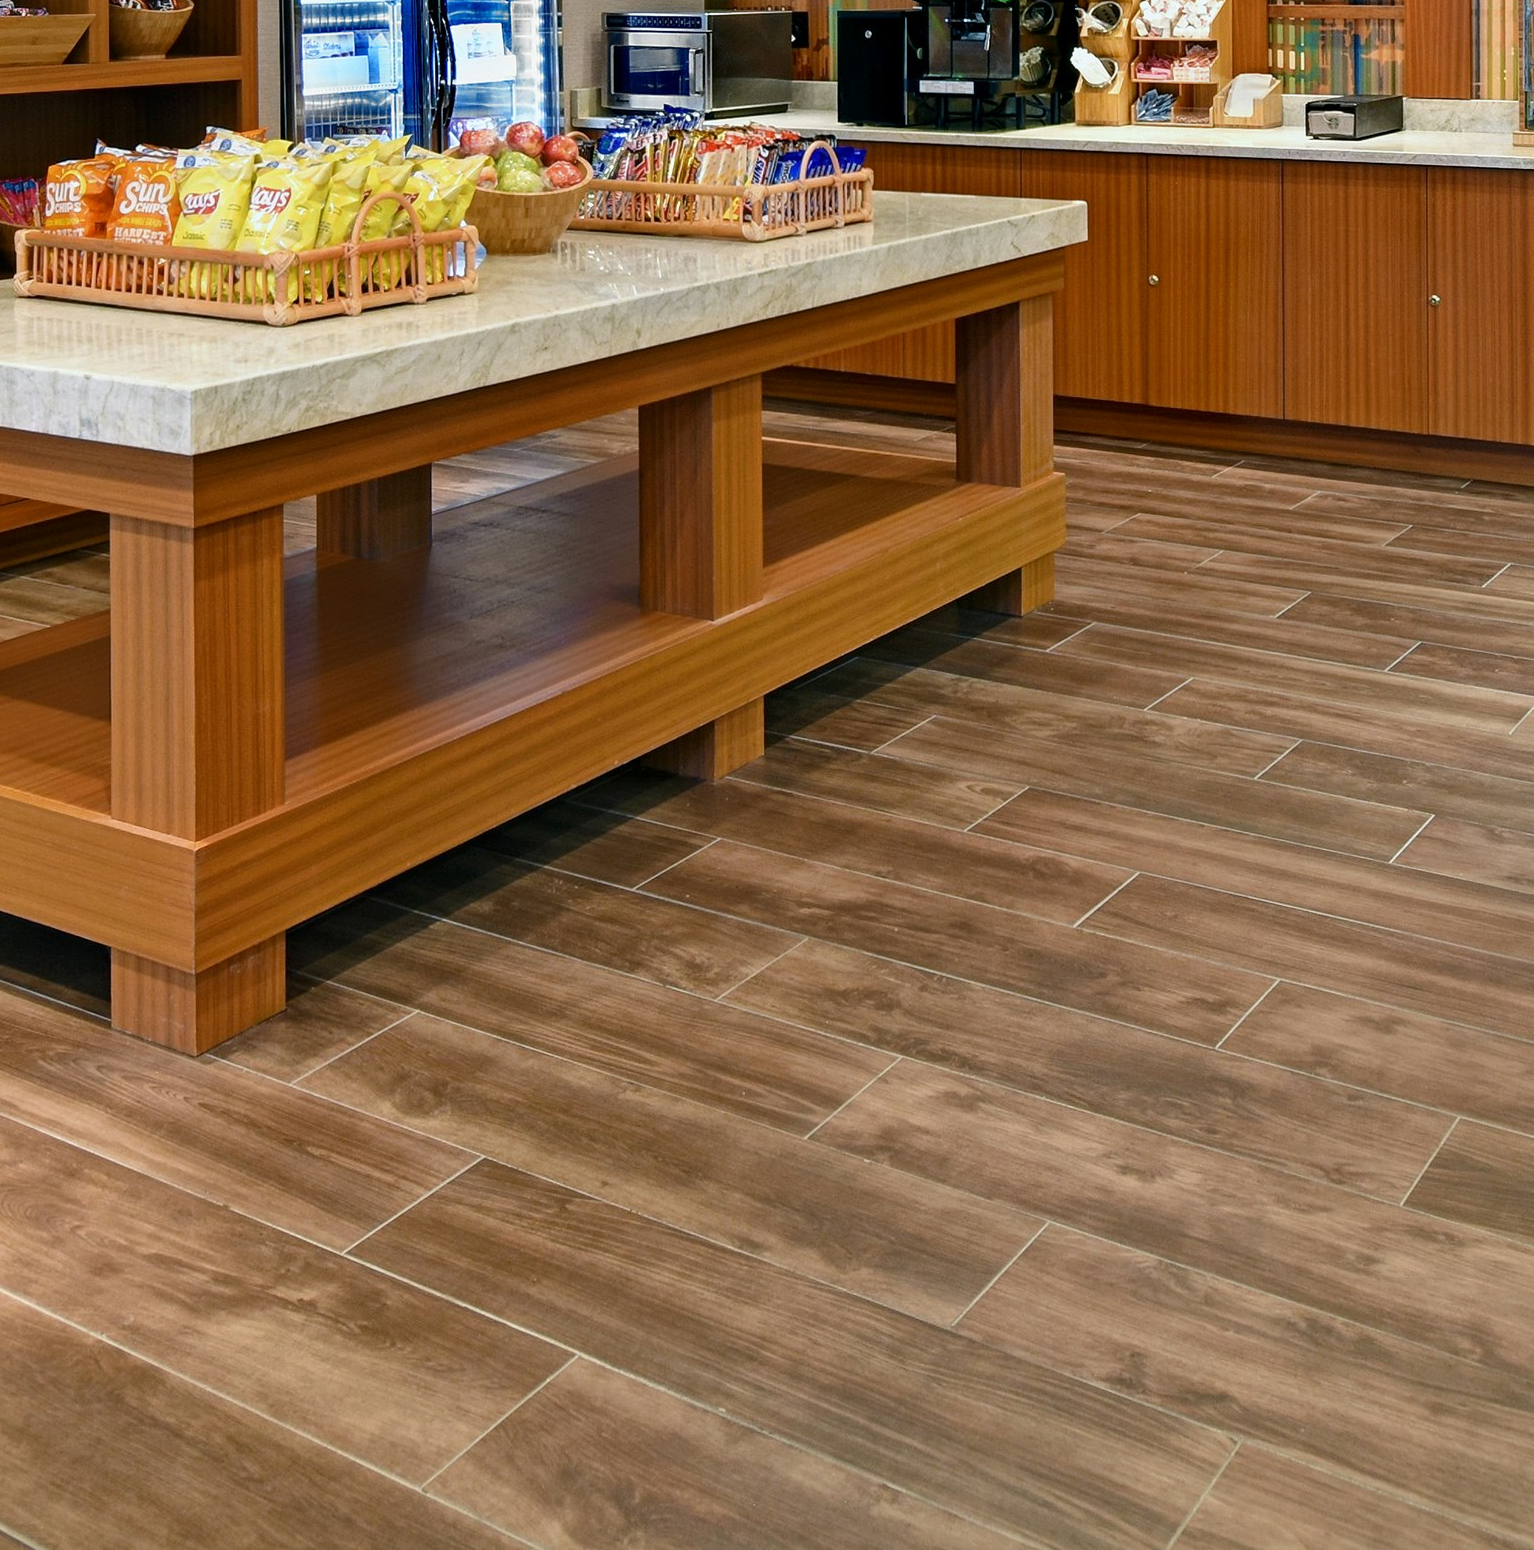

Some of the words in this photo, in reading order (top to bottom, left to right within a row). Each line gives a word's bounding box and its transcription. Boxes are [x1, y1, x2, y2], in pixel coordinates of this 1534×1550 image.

[45, 180, 82, 217] Sun
[119, 181, 171, 215] Sun
[55, 203, 82, 213] CHIPS
[135, 202, 168, 214] CHIPS
[114, 227, 167, 241] HARVEST
